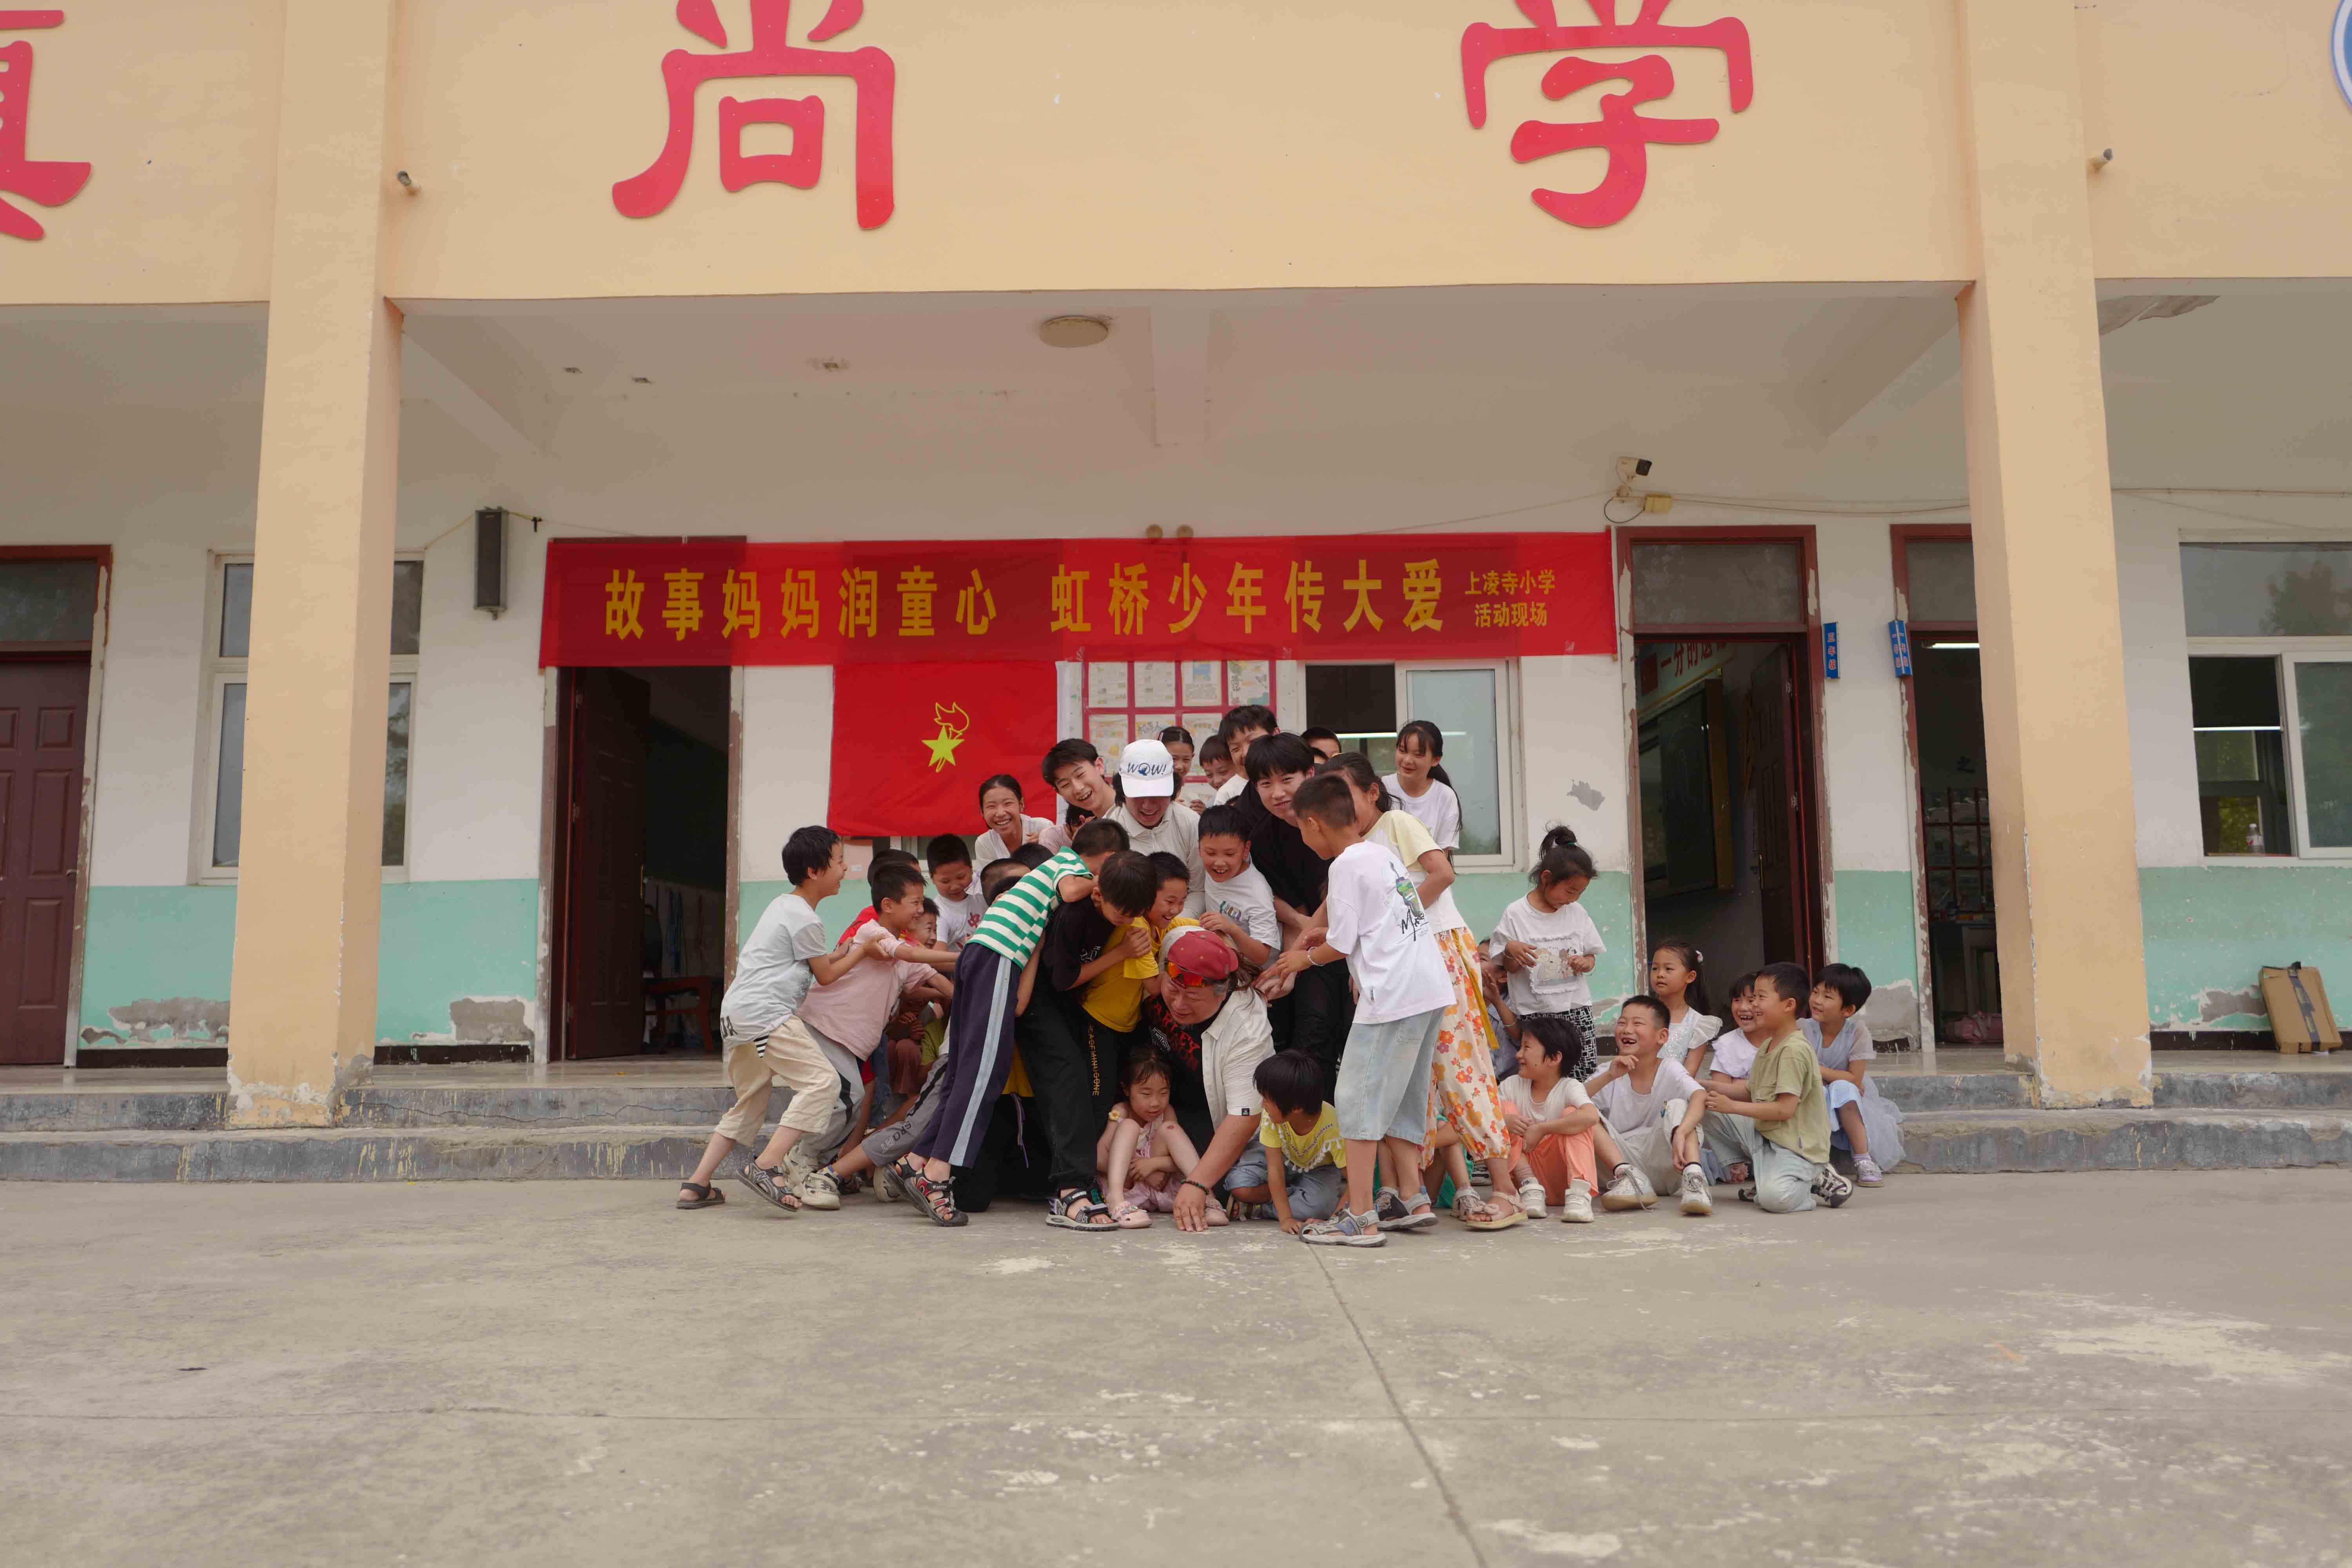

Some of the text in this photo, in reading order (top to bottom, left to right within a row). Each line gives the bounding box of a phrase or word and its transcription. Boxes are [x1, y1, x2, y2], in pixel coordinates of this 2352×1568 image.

[1465, 569, 1555, 595] 上凌寺小学
[605, 558, 1443, 641] 故事妈妈润童心 虹桥少年传大爱
[1474, 601, 1548, 627] 活动现场
[1127, 762, 1167, 776] WOW!
